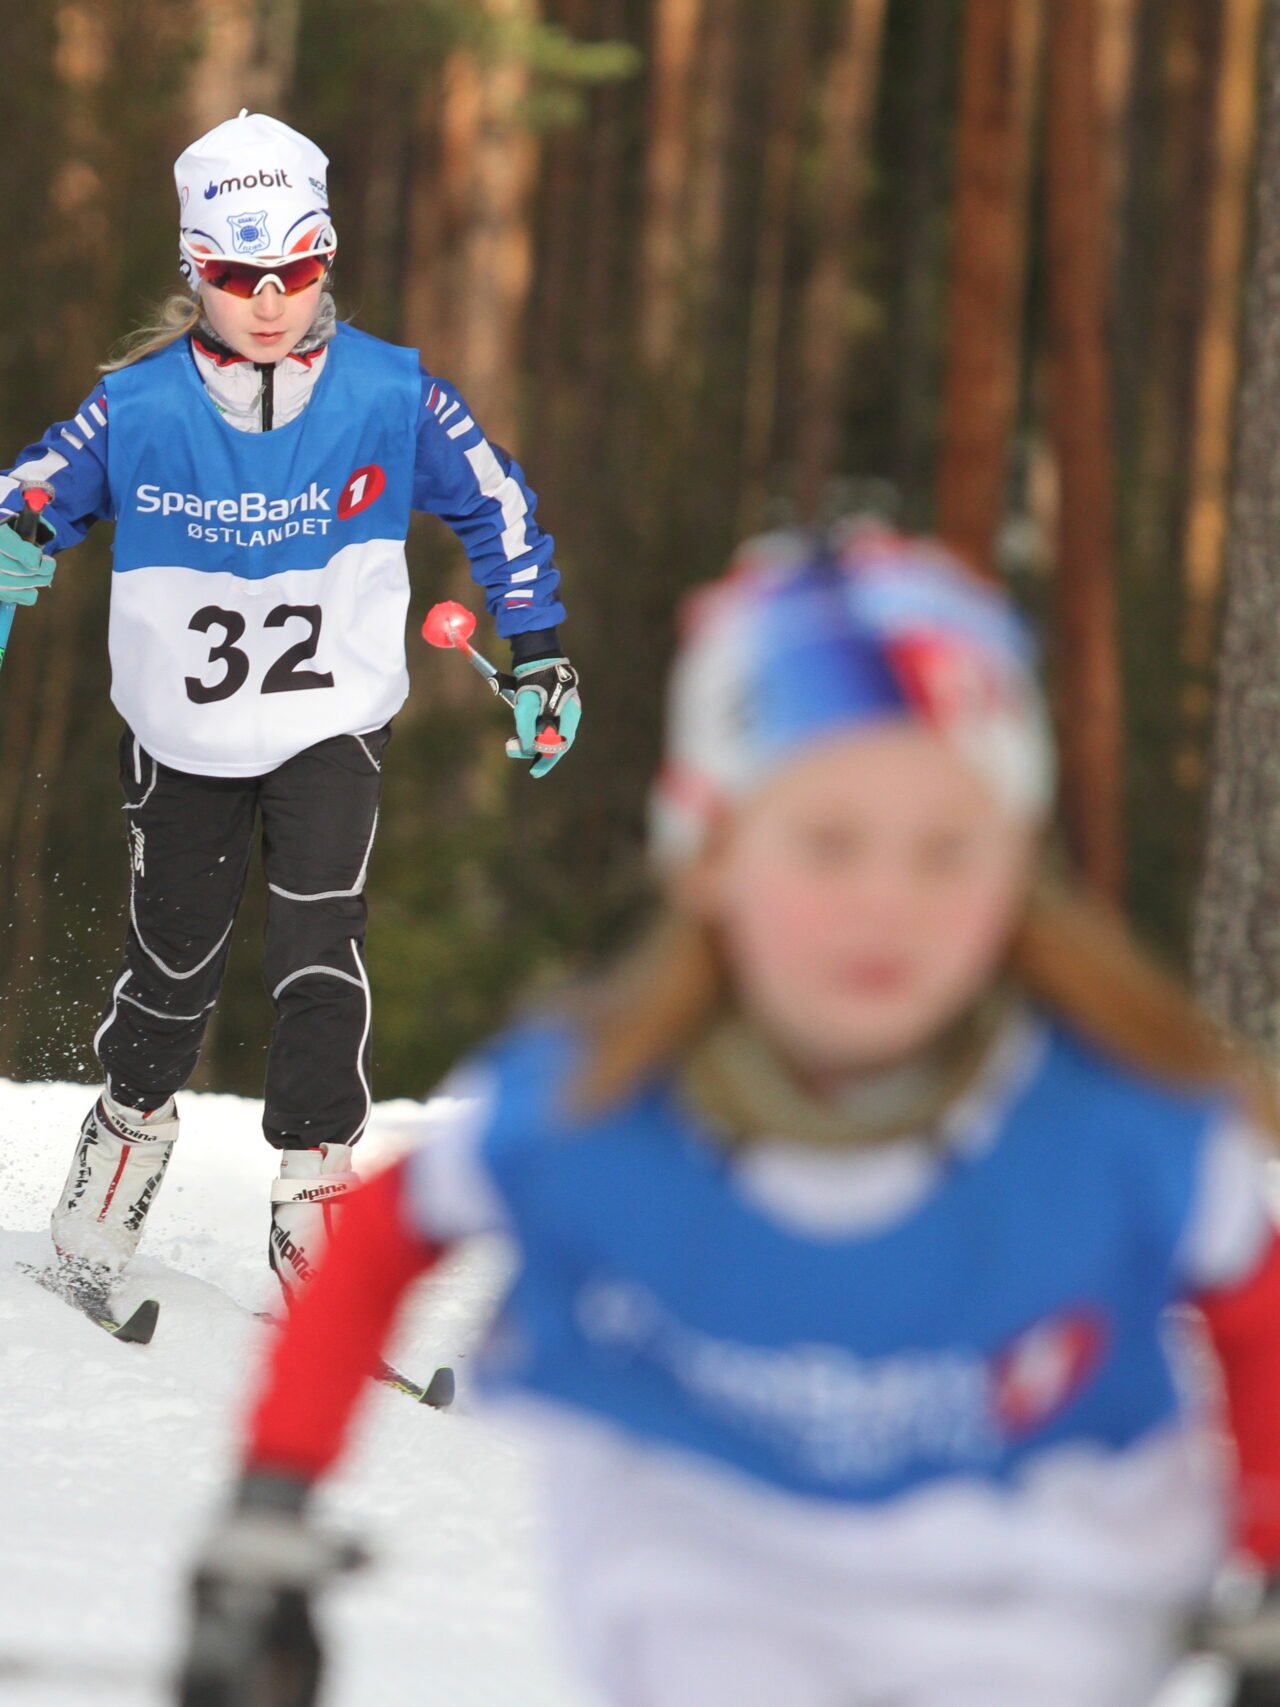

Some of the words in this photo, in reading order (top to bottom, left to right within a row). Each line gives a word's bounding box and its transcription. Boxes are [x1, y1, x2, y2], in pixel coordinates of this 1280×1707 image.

[219, 169, 293, 195] mobit
[135, 482, 331, 522] SpareBank
[187, 518, 332, 547] ØSTLANDET
[184, 604, 335, 704] 32
[292, 1183, 347, 1201] alpina
